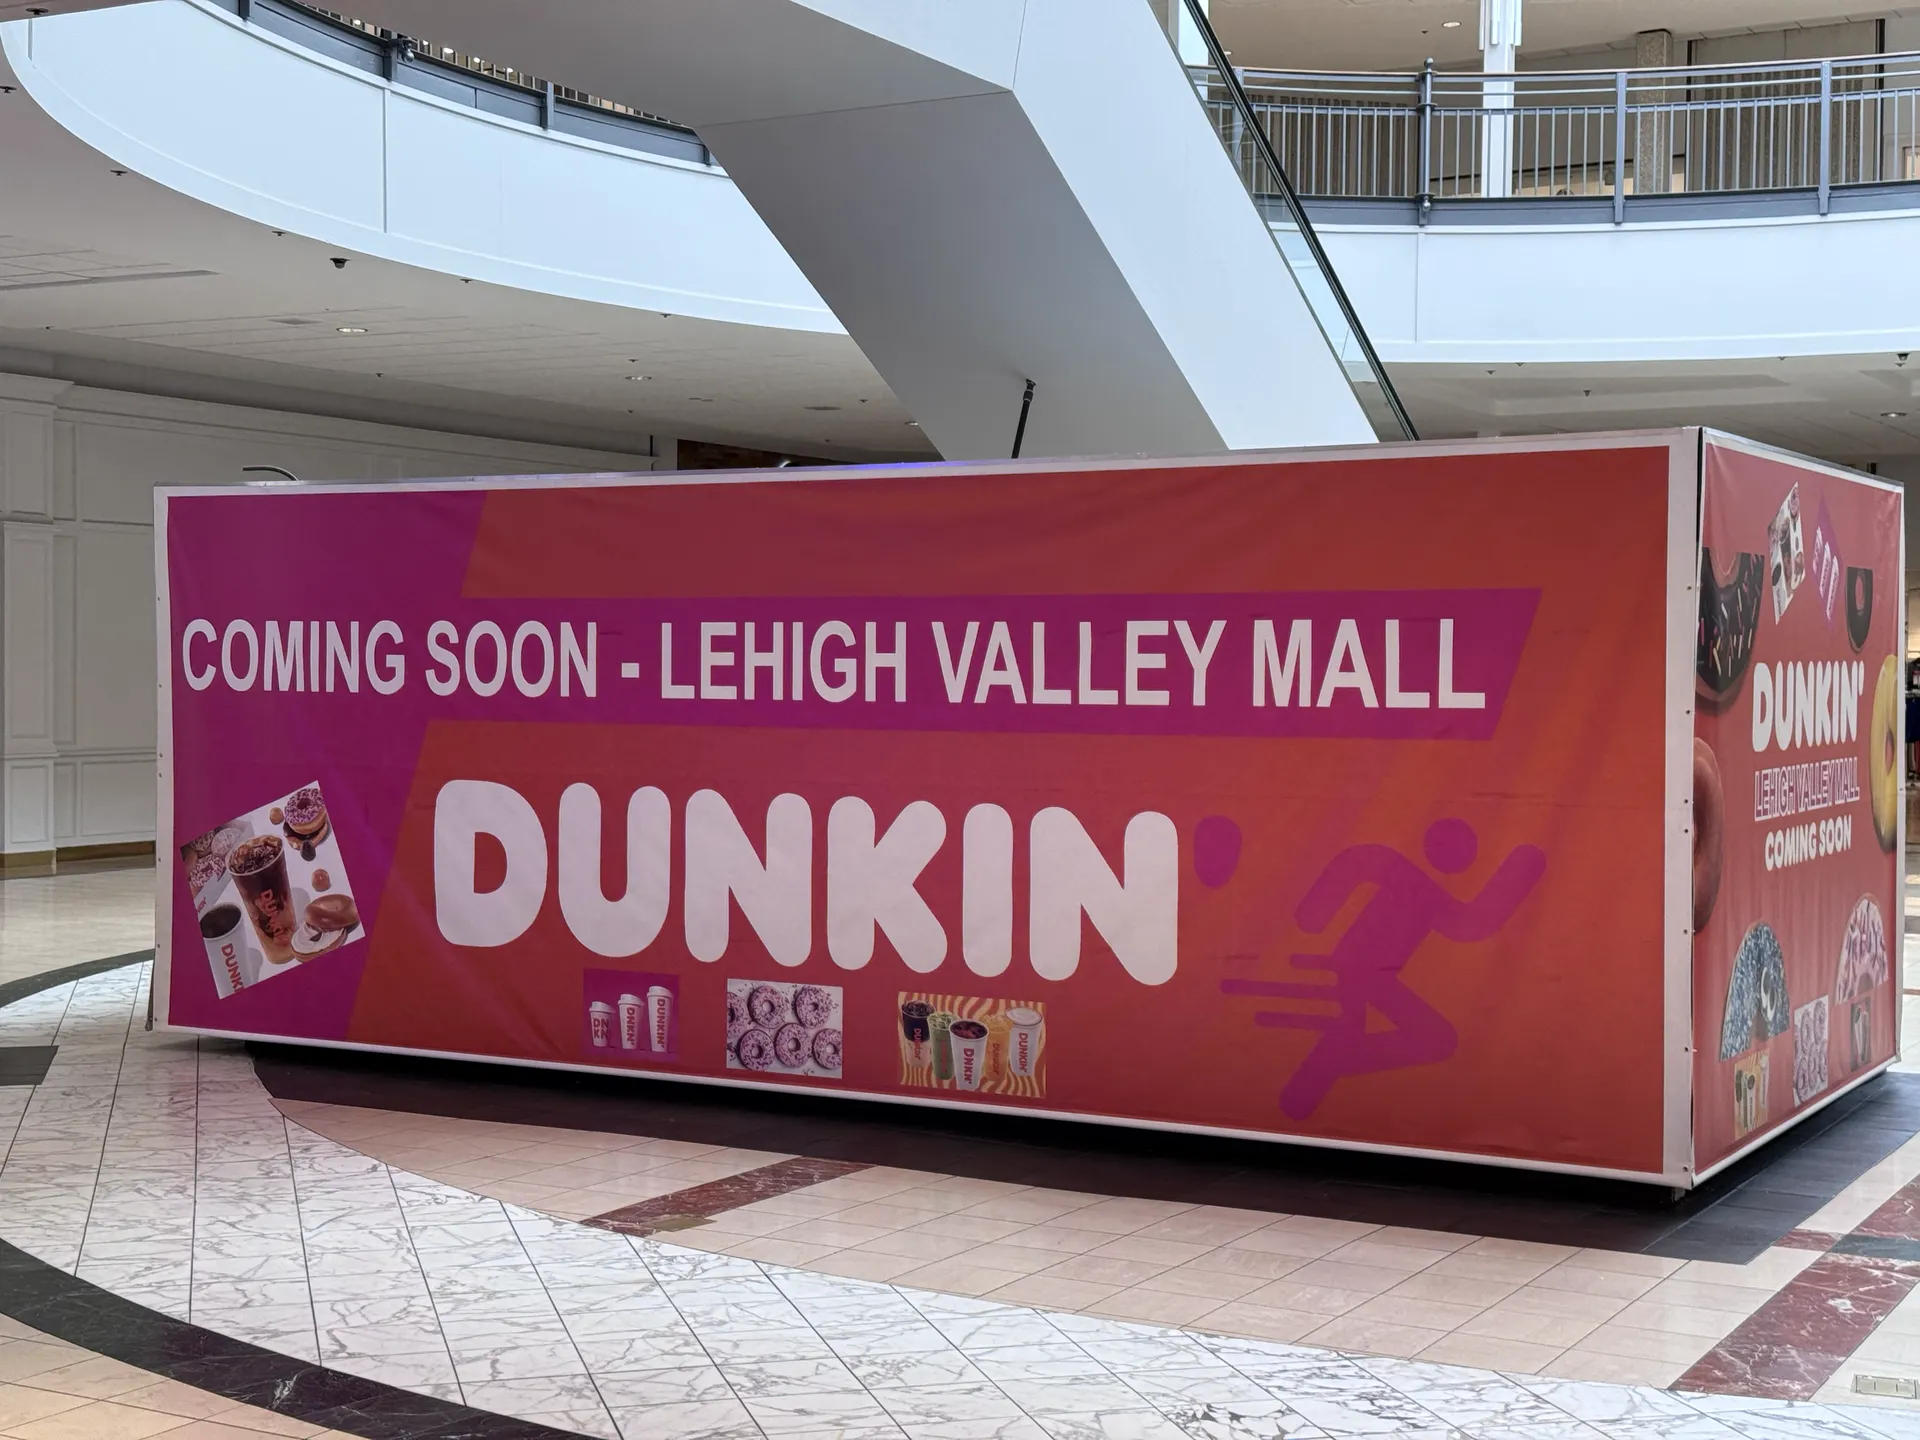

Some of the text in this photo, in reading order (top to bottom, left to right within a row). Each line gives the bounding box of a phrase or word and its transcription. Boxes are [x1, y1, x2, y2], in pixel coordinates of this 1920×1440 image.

[182, 617, 1487, 709] COMING SOON - LEHIGH VALLEY MALL
[1752, 660, 1865, 753] DUNKIN'
[1754, 756, 1861, 822] LEHIGH VALLEY MALL
[1765, 814, 1852, 872] COMING SOON
[433, 779, 1243, 986] DUNKIN'
[626, 1007, 636, 1046] DNKN'
[1018, 1032, 1029, 1073] DUNKIN'
[963, 1047, 975, 1085] DNKN'
